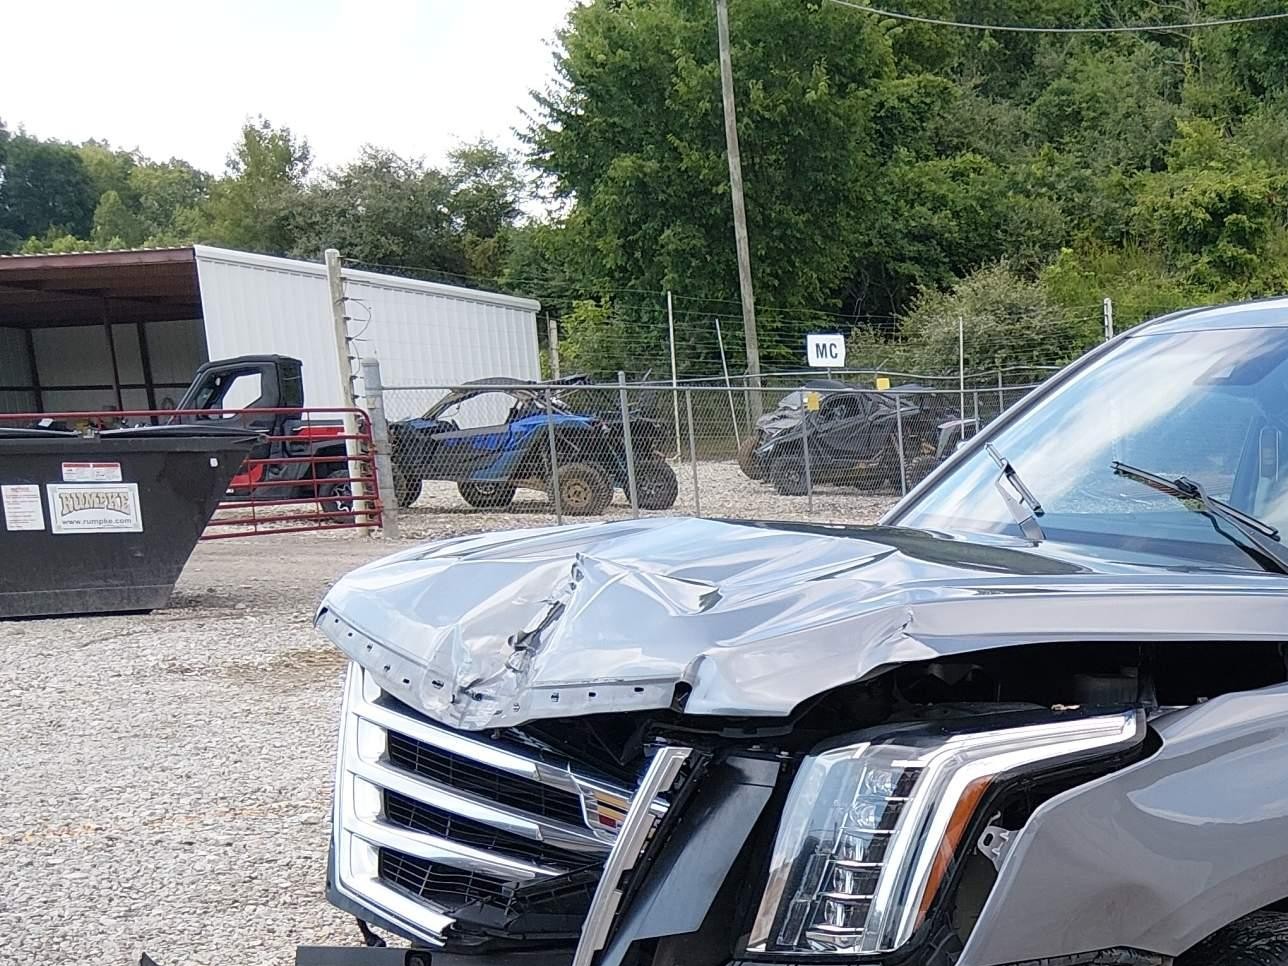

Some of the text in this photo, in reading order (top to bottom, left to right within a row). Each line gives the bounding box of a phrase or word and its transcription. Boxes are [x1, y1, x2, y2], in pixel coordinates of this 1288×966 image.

[815, 342, 838, 359] MC
[59, 491, 131, 516] RUMPKE
[62, 517, 132, 526] www.rumpke.com
